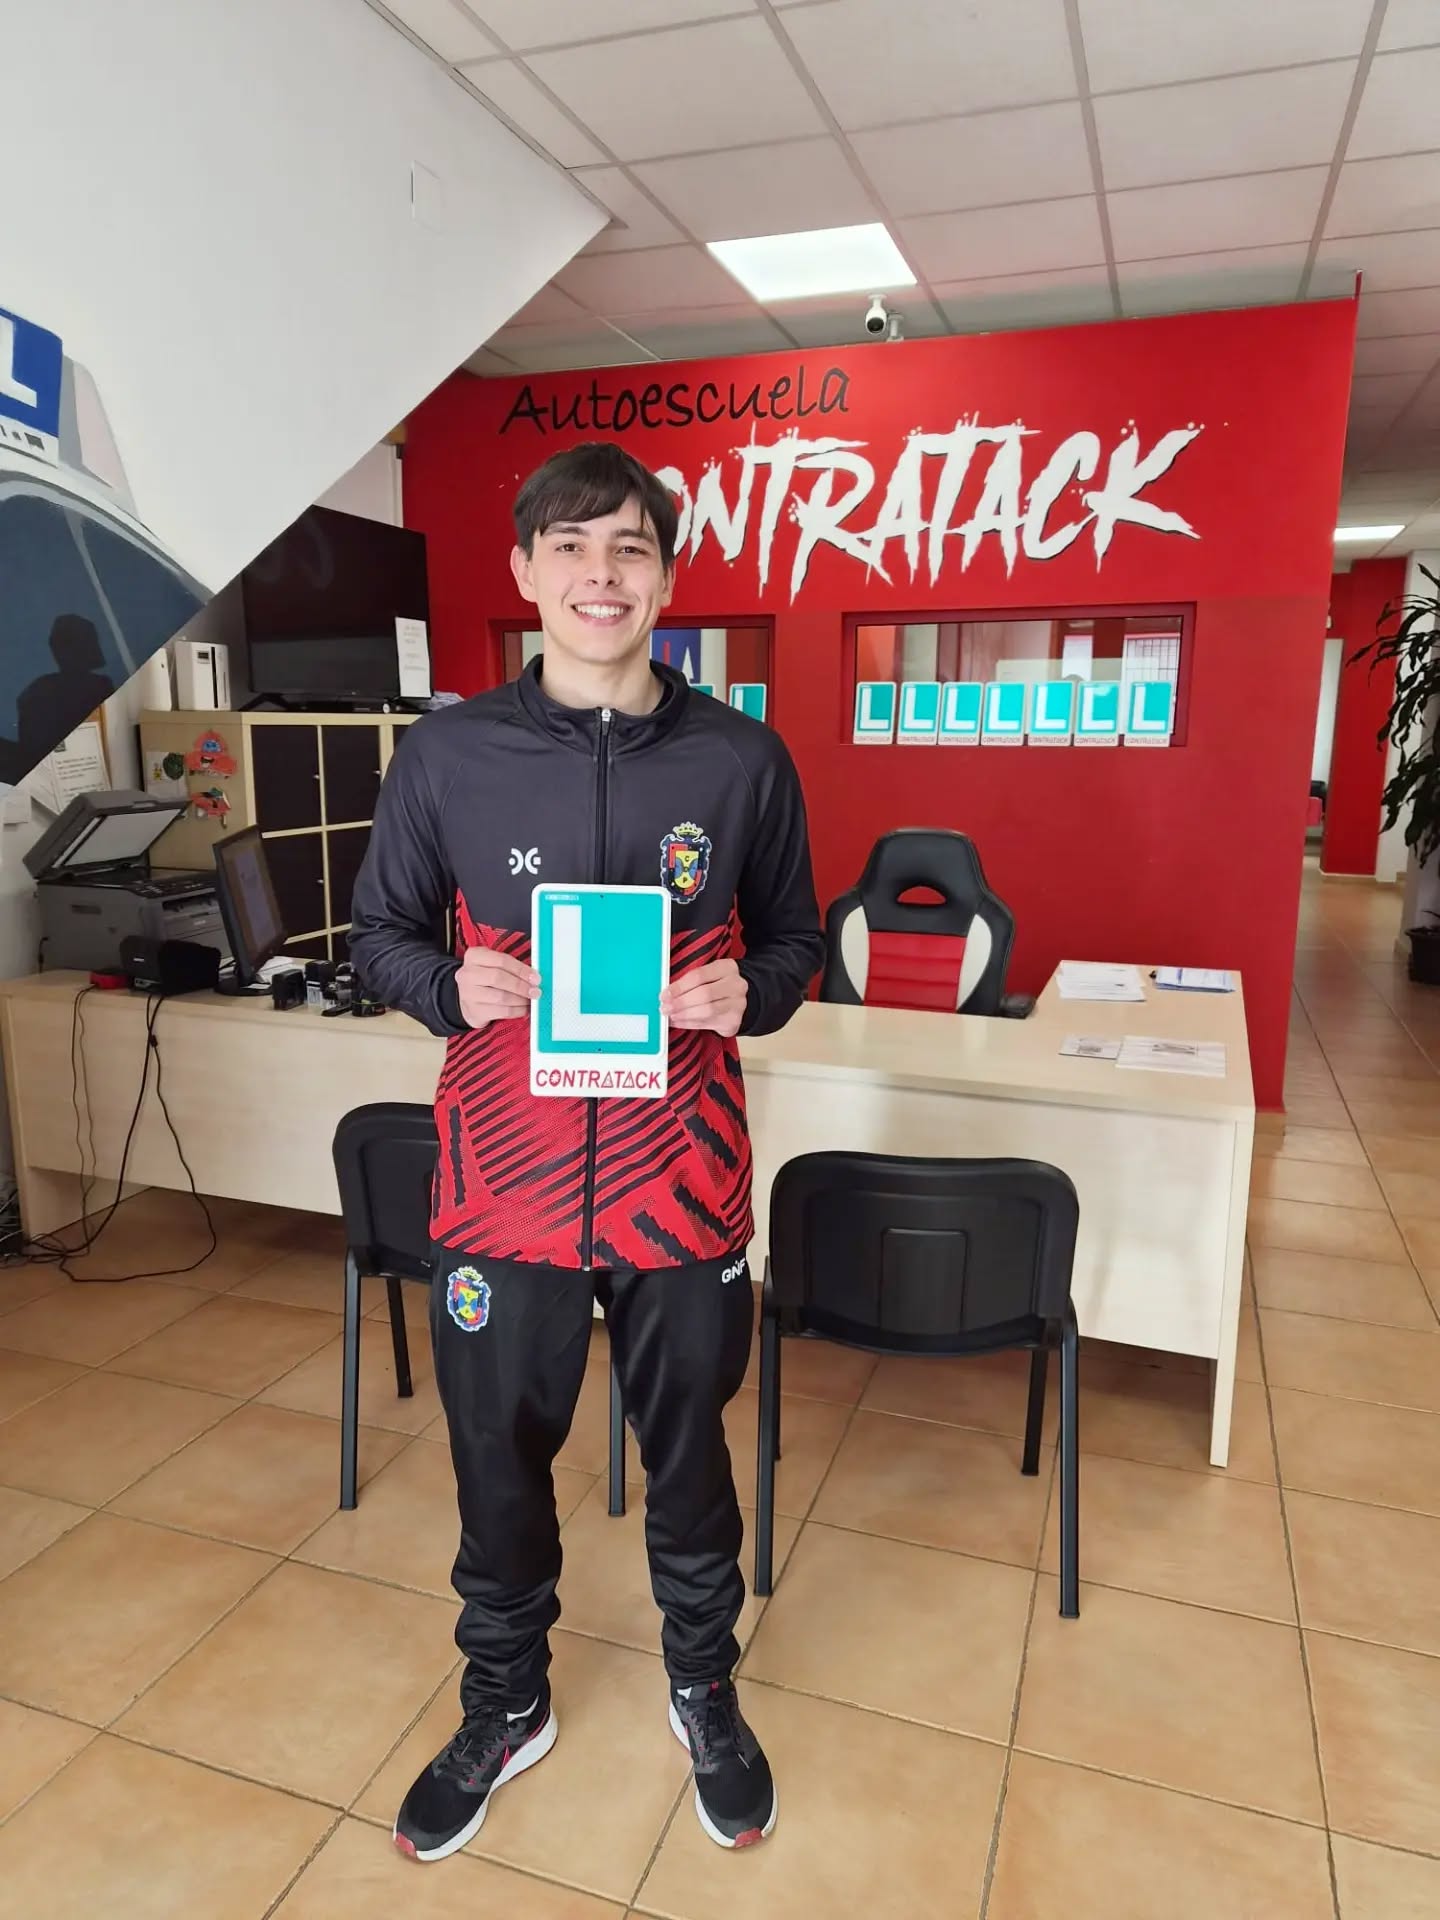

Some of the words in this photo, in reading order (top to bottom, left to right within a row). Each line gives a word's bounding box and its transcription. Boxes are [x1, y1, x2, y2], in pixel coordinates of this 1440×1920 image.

[499, 365, 850, 435] Autoescuela
[654, 412, 1203, 606] ONTRATACK
[859, 687, 890, 730] L
[903, 687, 934, 730] L
[944, 687, 976, 731] L
[988, 687, 1020, 731] L
[1034, 685, 1067, 730] L
[1081, 686, 1115, 731] L
[1131, 685, 1166, 731] L
[551, 904, 649, 1042] L
[535, 1069, 661, 1089] CONTRATACK
